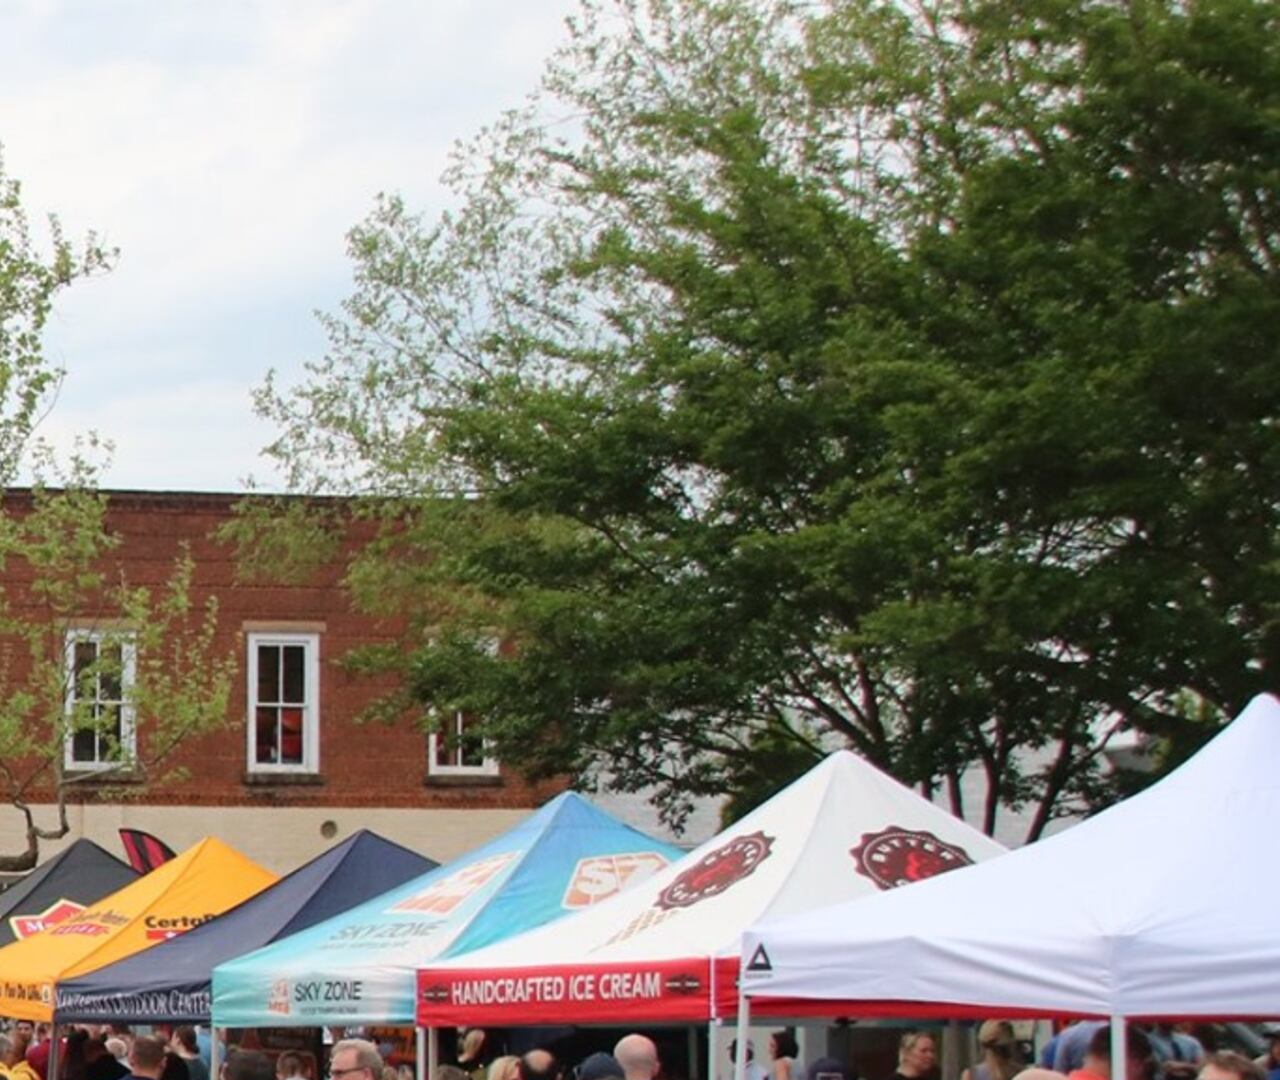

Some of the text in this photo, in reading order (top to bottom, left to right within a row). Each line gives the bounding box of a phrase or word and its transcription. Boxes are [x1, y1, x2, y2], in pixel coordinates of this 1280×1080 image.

[871, 839, 953, 862] BUTTER
[294, 981, 321, 1002] SKY
[324, 981, 362, 1001] ZONE
[452, 971, 661, 1005] HANDCRAFTED ICE CREAM
[114, 993, 168, 1015] OUTDOOR
